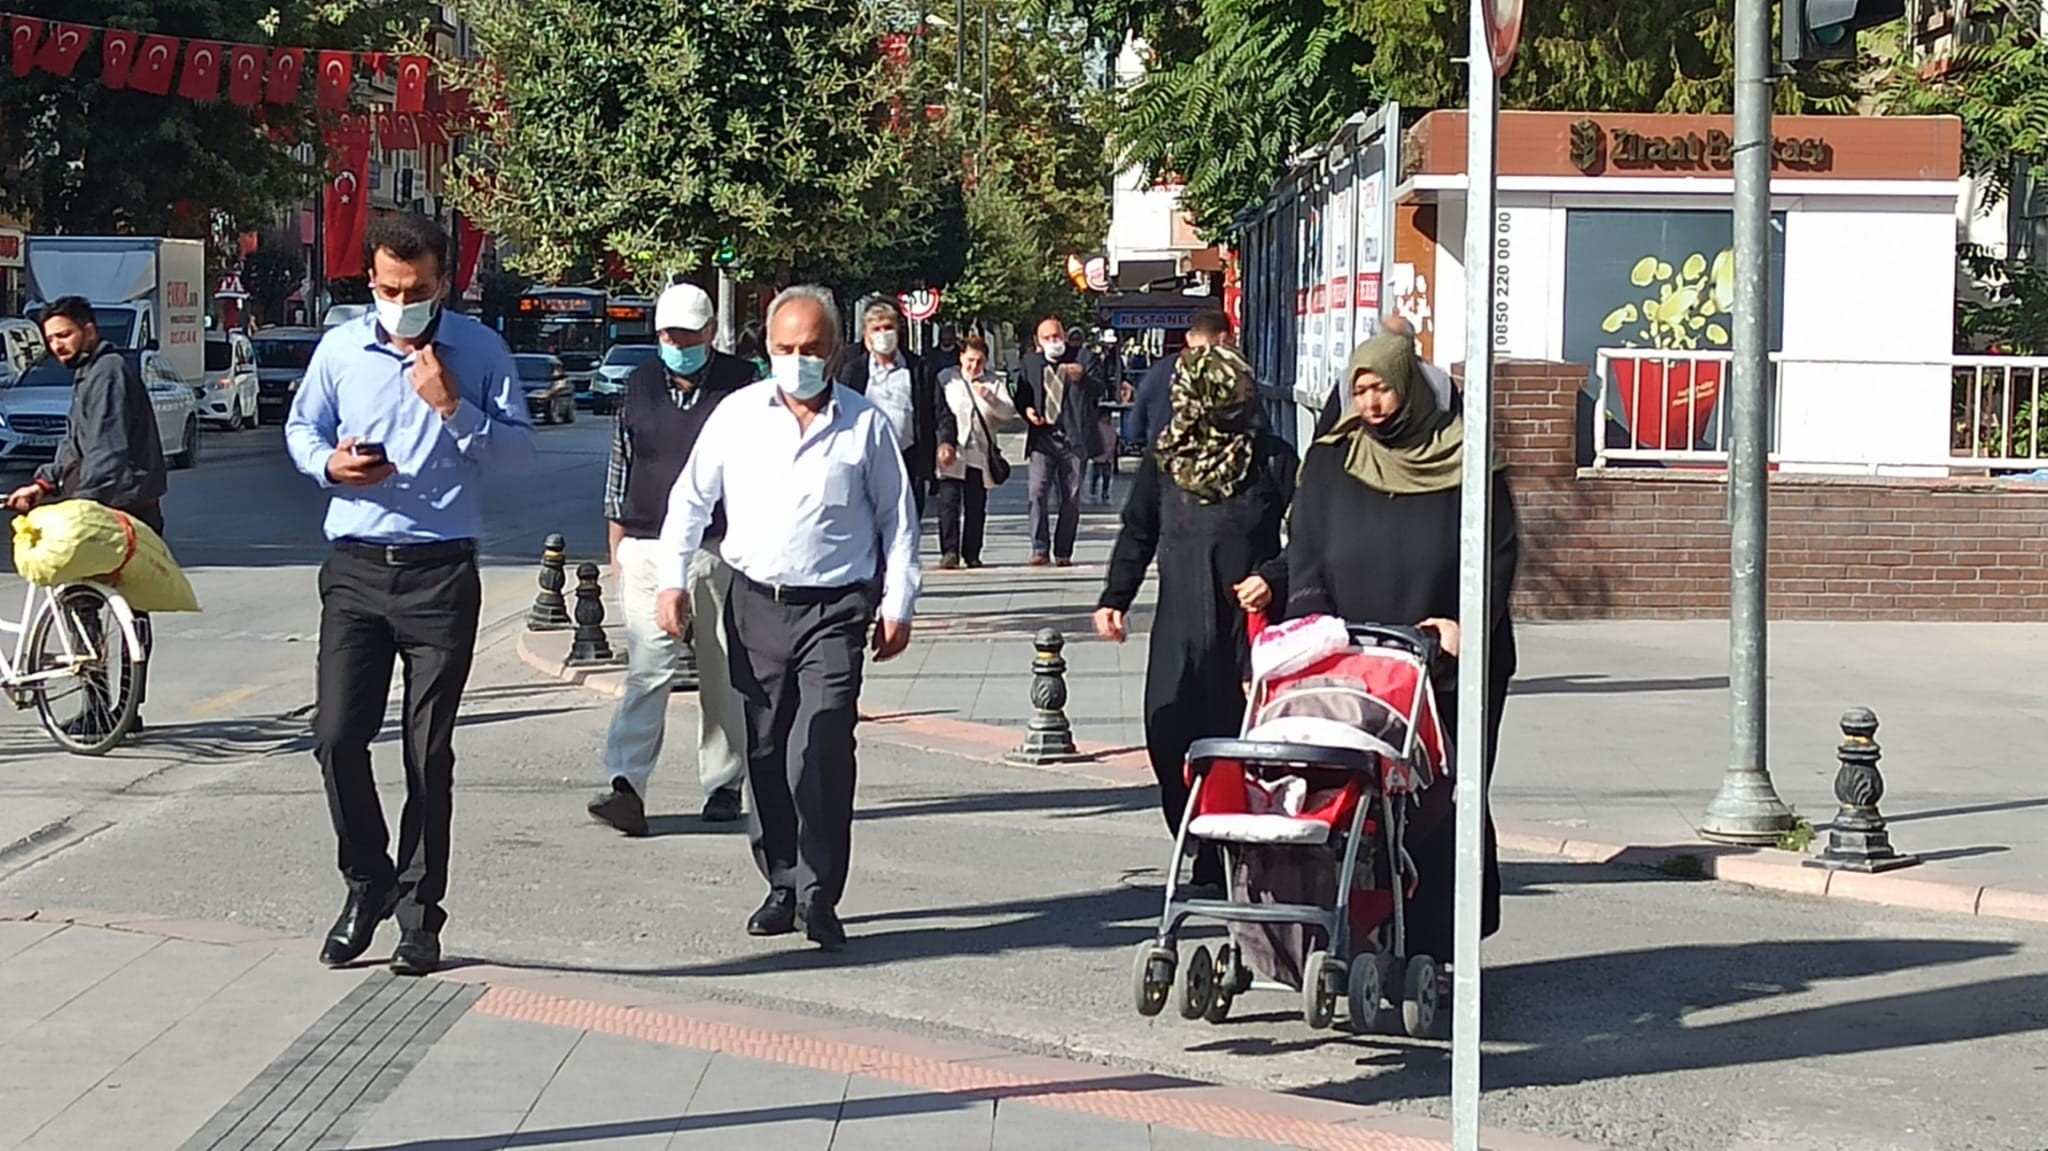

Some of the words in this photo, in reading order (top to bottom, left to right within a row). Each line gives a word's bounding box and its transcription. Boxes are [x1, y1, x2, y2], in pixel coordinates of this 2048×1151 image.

[1610, 127, 1700, 162] Ziraat
[1498, 211, 1512, 234] 00
[1497, 237, 1511, 260] 00
[1496, 264, 1511, 297] 220
[1494, 301, 1510, 346] 0850
